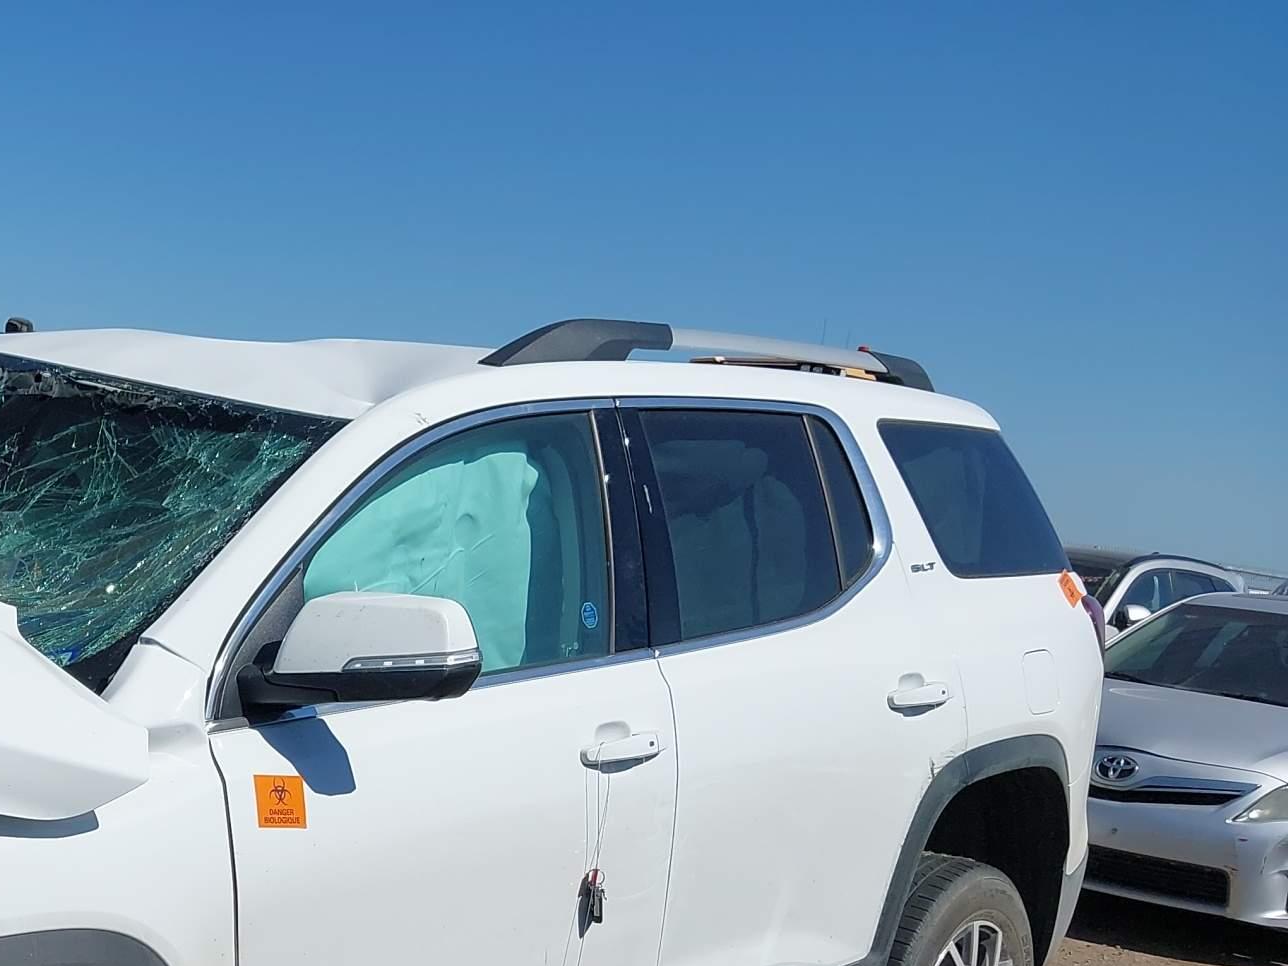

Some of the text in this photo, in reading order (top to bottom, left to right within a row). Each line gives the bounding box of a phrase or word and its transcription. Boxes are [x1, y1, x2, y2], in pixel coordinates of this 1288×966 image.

[911, 561, 936, 573] SLT
[269, 808, 294, 816] DANGER
[264, 816, 300, 824] BIOLOGIQUE
